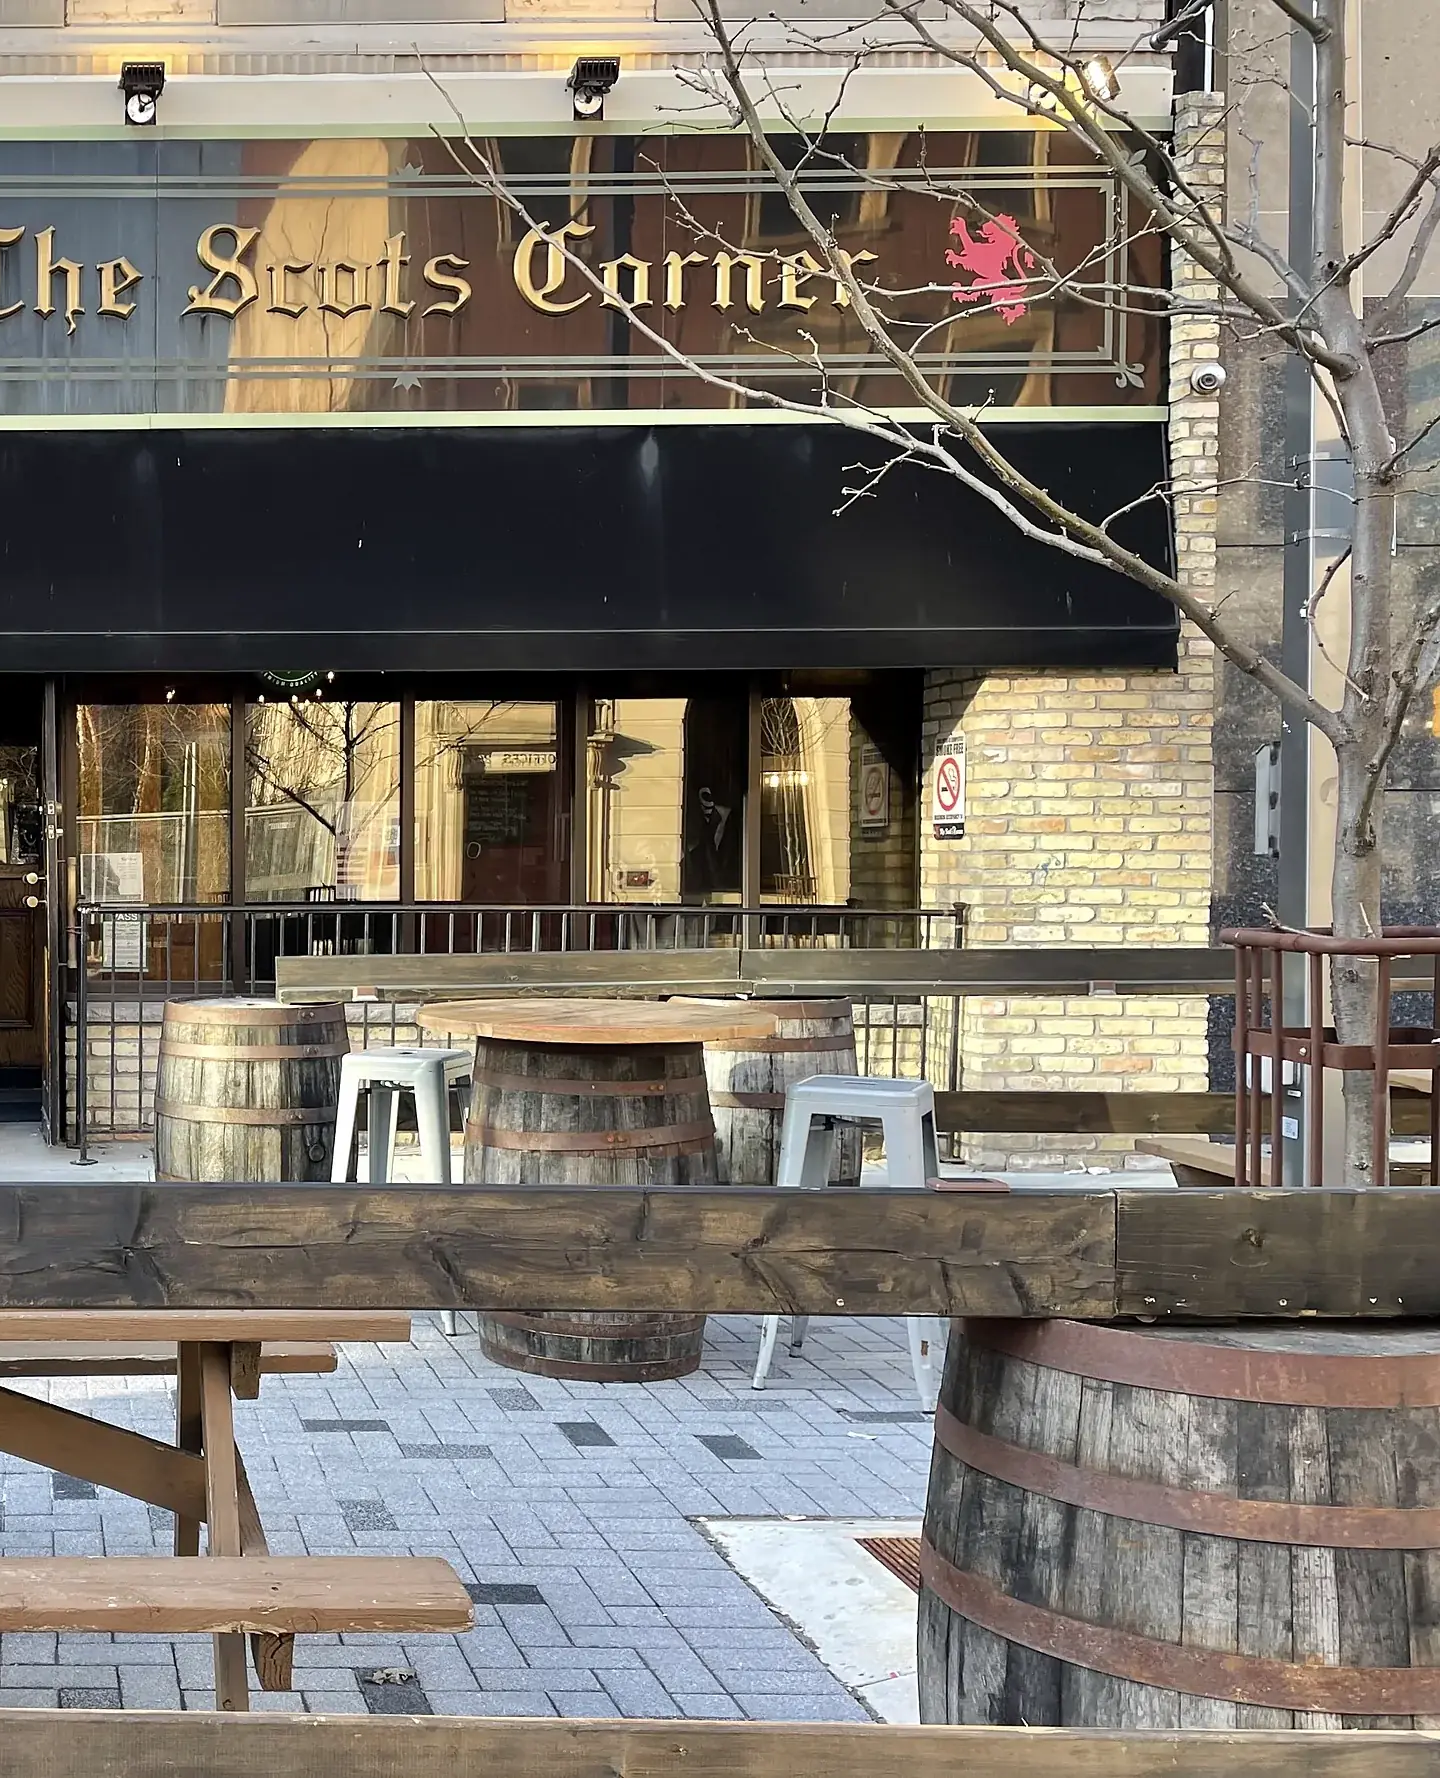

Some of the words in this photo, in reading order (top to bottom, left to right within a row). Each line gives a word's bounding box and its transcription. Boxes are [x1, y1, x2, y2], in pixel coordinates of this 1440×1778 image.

[180, 223, 474, 321] Scots
[511, 219, 880, 318] Corner
[953, 742, 964, 755] FREE
